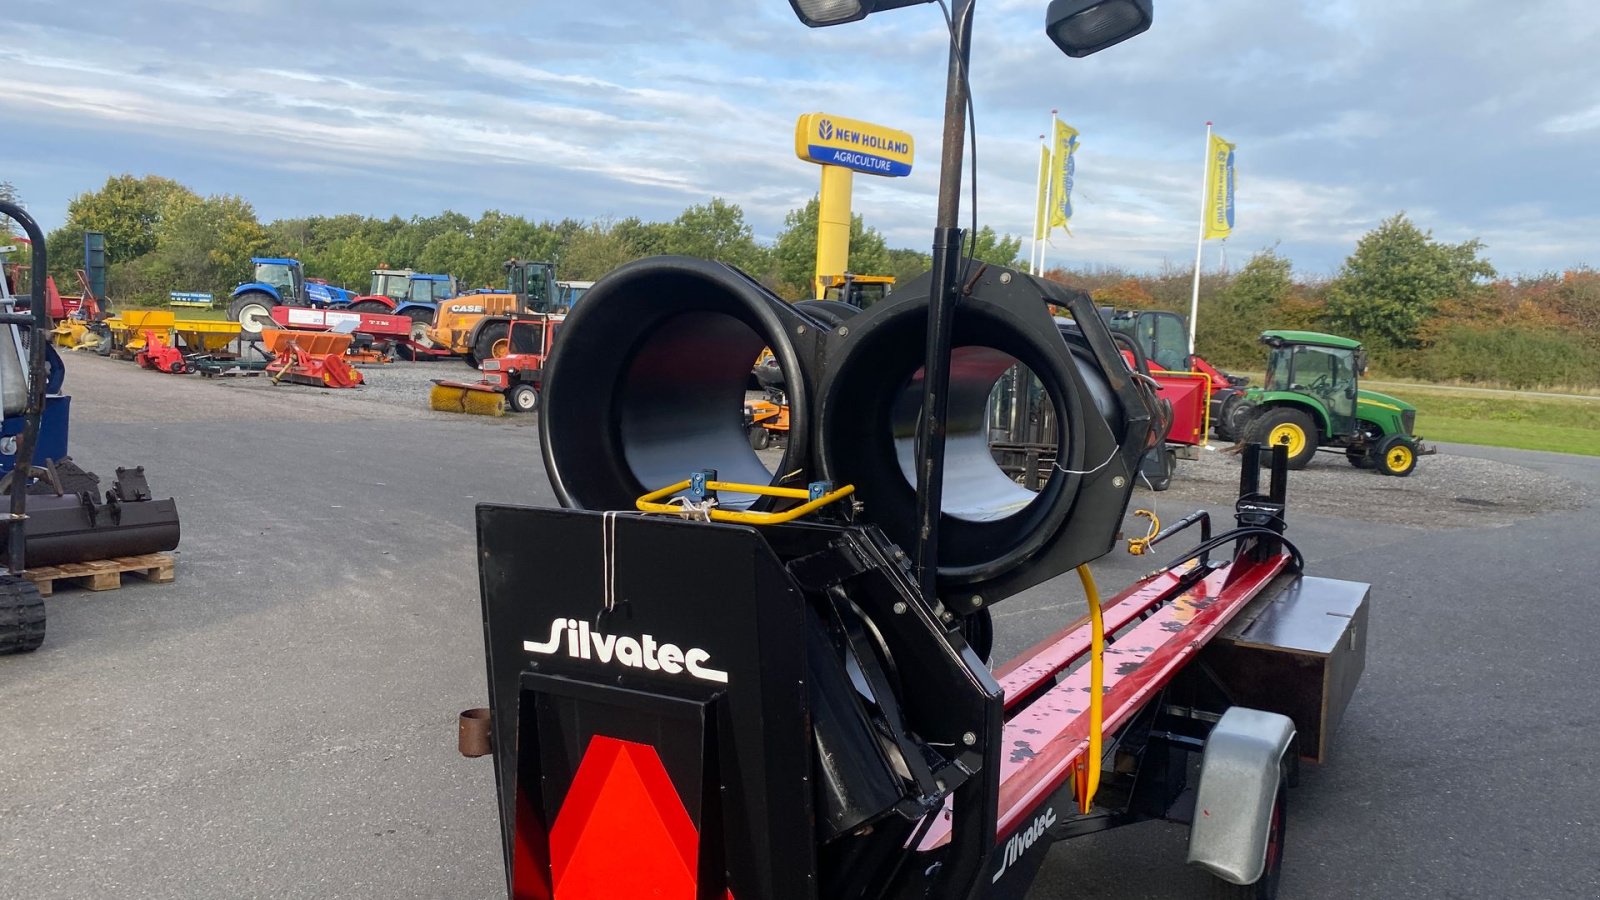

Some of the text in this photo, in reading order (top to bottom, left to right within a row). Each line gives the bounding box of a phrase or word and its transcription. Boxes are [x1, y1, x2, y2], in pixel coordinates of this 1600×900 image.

[836, 128, 909, 154] NEW HOLLAND
[834, 151, 891, 170] AGRICULTURE
[451, 304, 483, 312] CASE
[523, 617, 729, 683] Silvatec
[992, 807, 1057, 884] Silvatec
